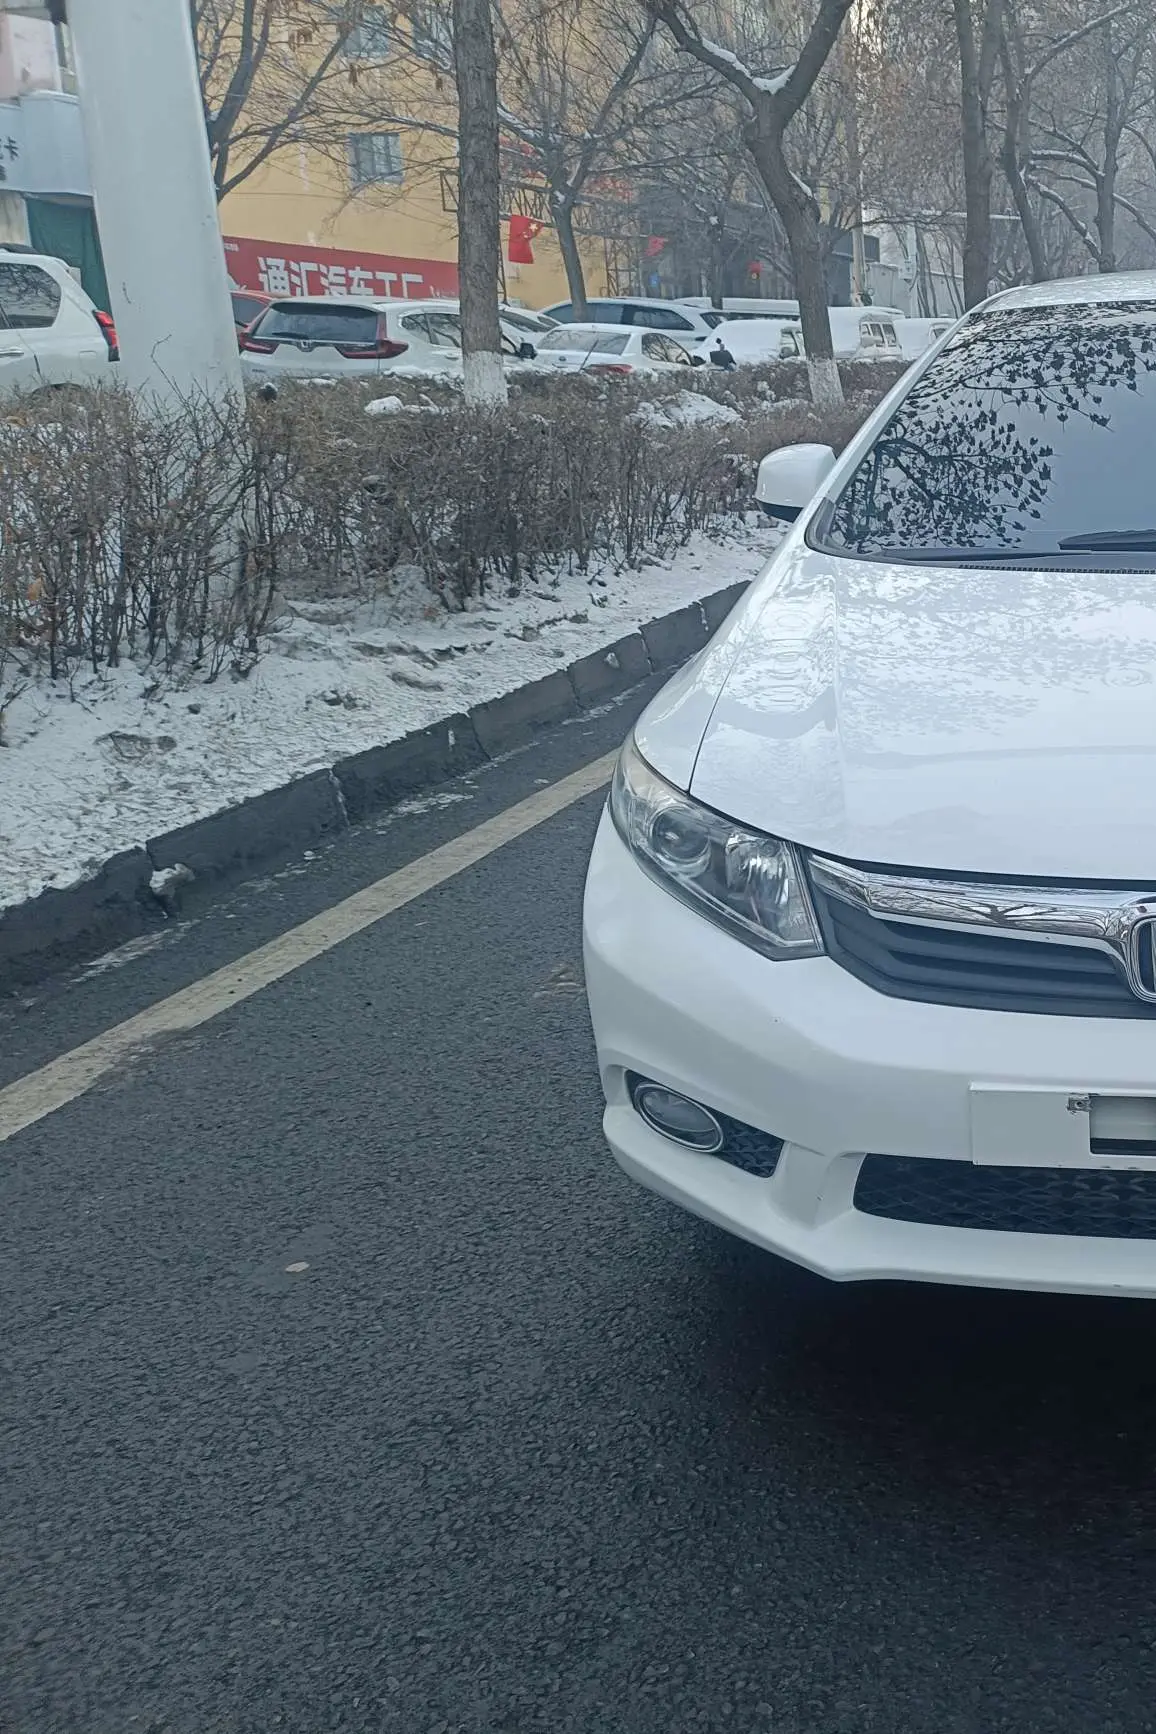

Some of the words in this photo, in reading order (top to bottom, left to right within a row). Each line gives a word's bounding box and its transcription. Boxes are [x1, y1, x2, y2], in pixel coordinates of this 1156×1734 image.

[257, 256, 424, 298] 通汇汽车工厂
